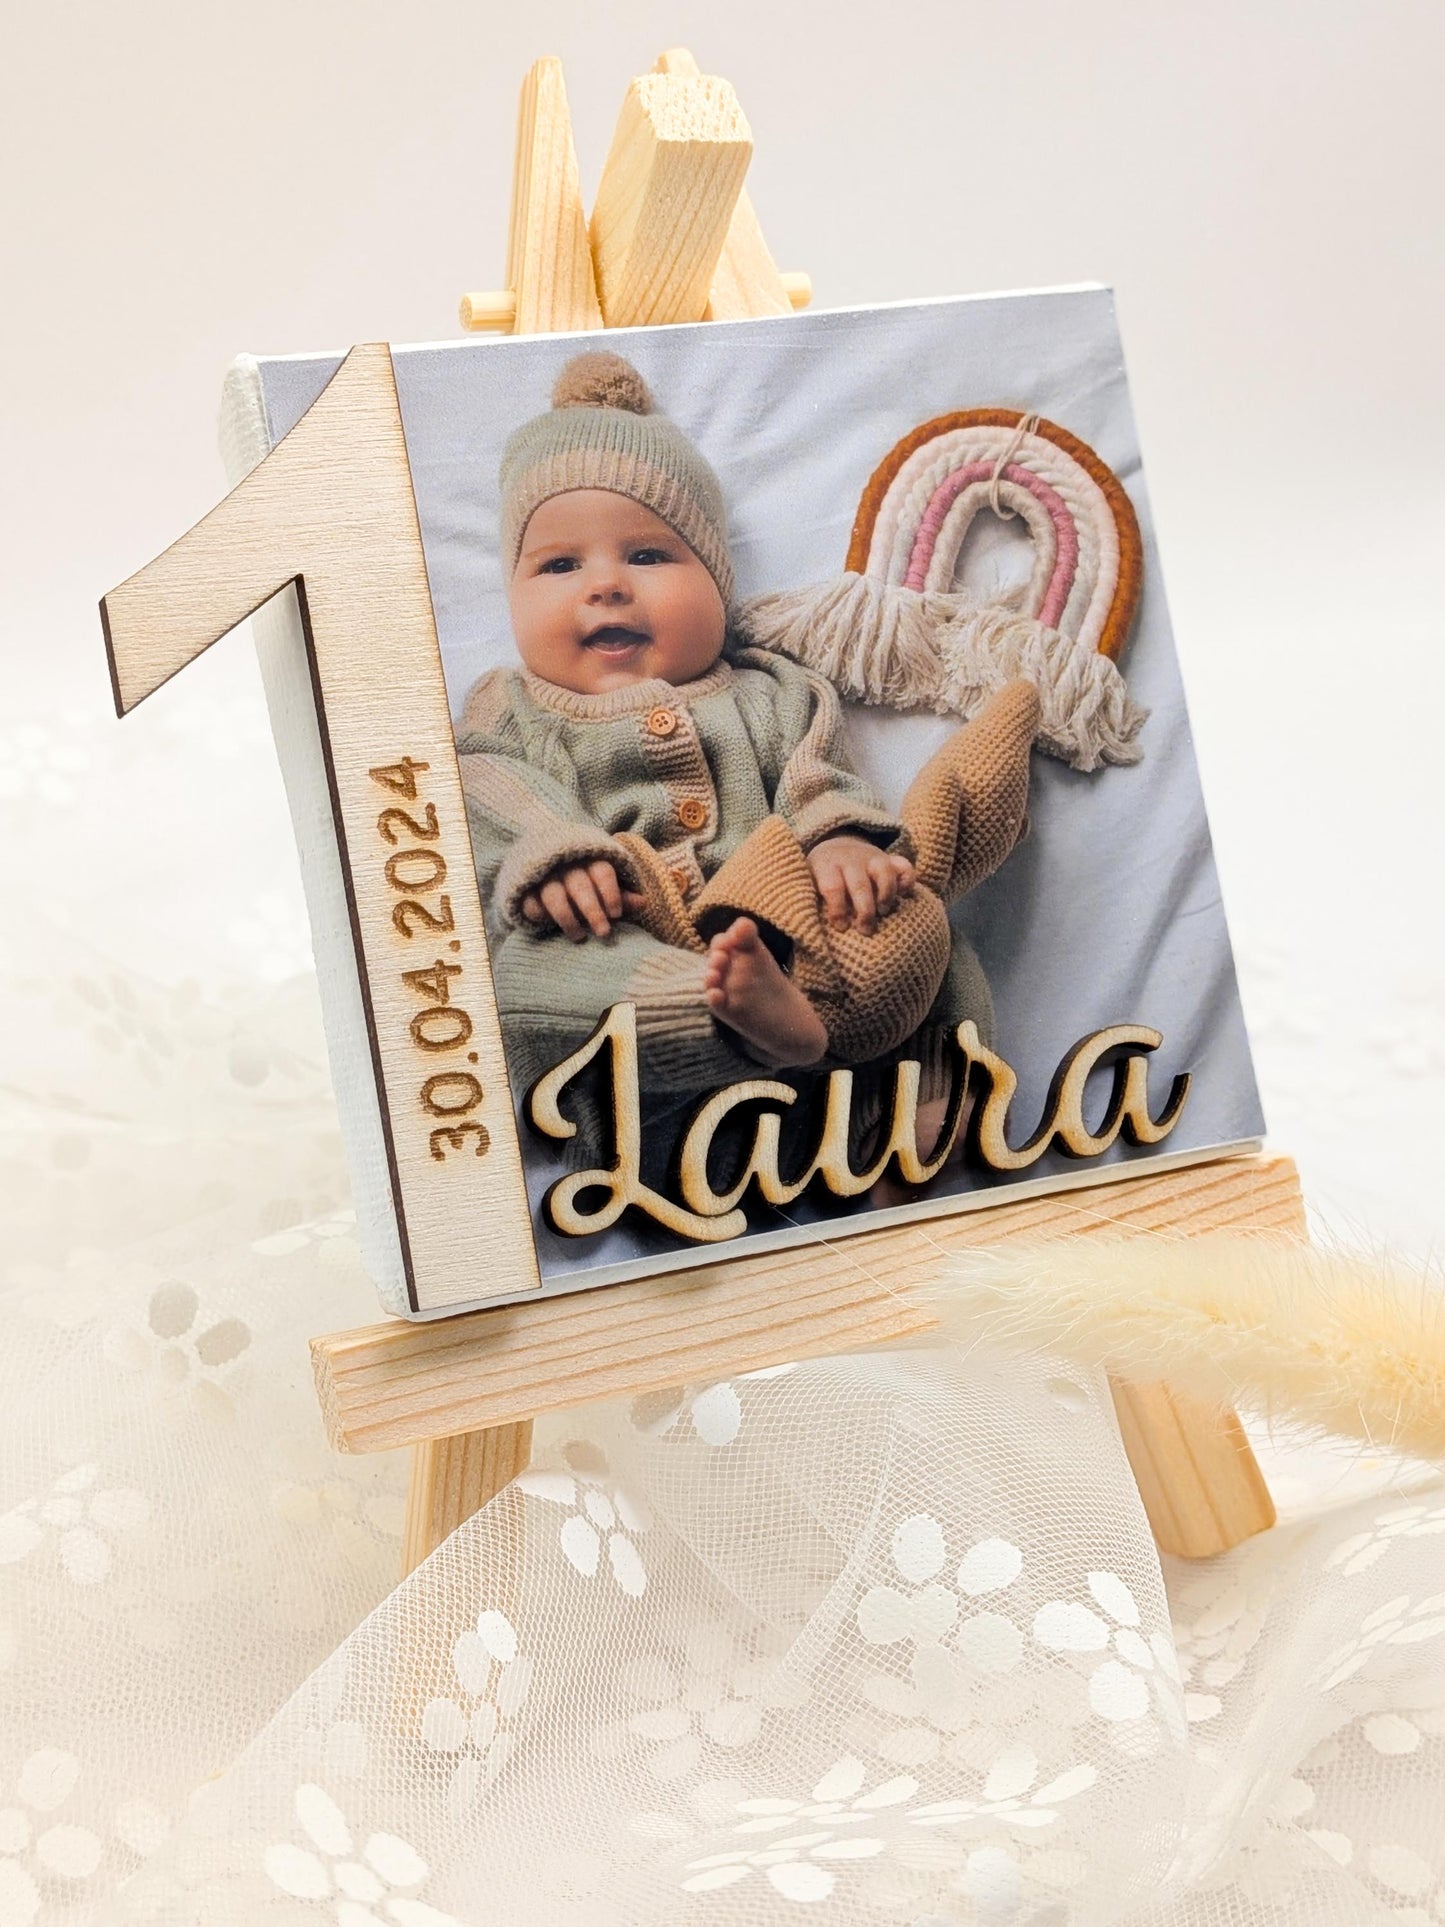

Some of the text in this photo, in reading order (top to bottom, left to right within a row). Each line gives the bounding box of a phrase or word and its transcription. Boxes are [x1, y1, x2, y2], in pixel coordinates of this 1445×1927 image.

[100, 342, 541, 1311] 1
[369, 756, 491, 1161] 30.04.2024
[526, 1002, 1191, 1243] Laura
